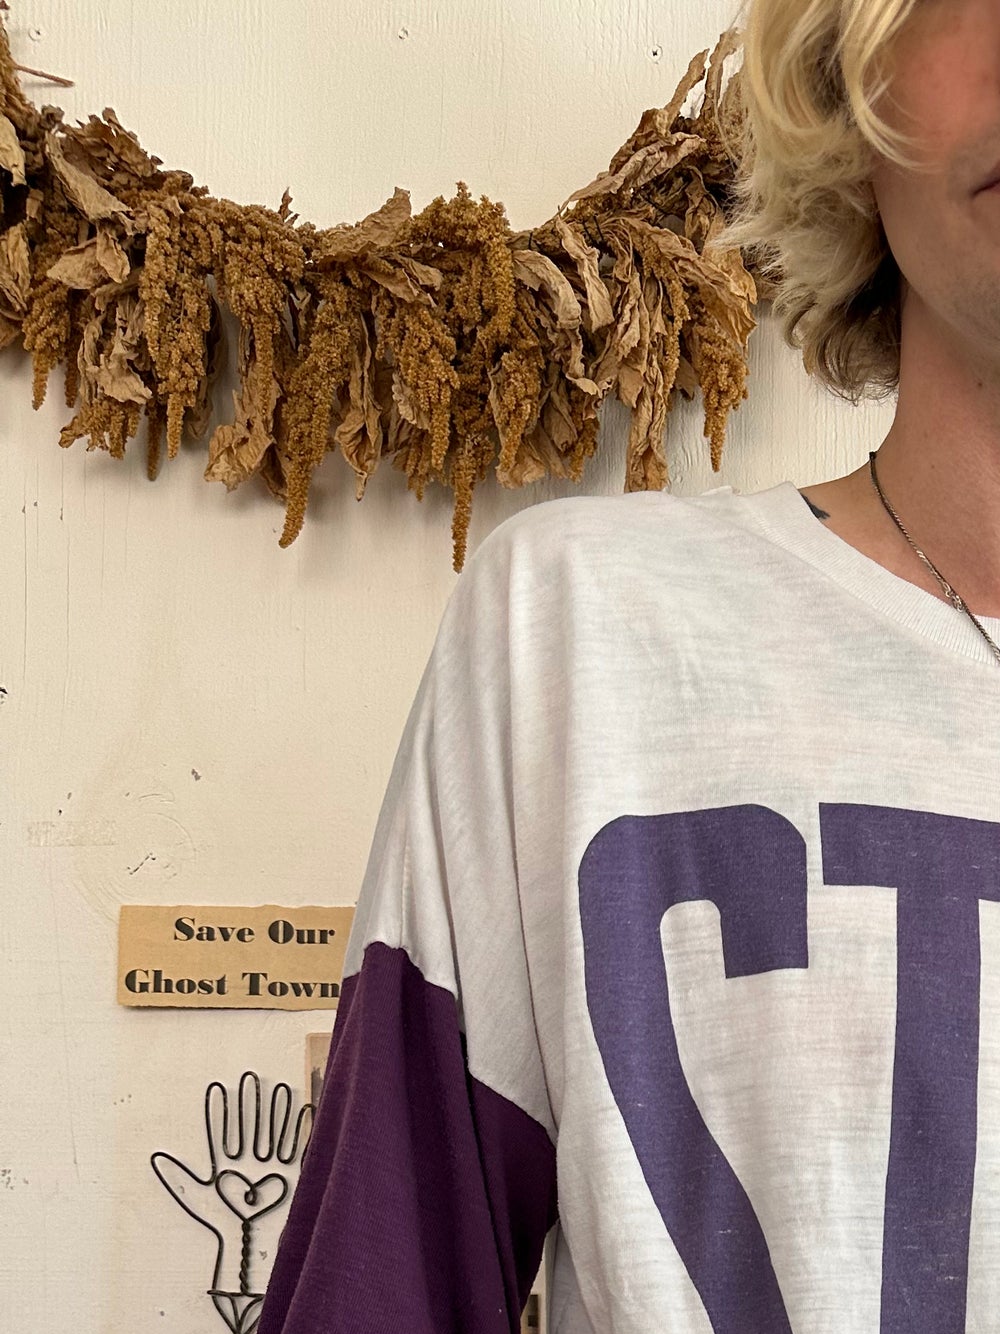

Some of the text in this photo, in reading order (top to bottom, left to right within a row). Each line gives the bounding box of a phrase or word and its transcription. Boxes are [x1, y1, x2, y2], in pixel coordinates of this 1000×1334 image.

[174, 917, 335, 944] Save Our
[125, 968, 228, 995] Ghost
